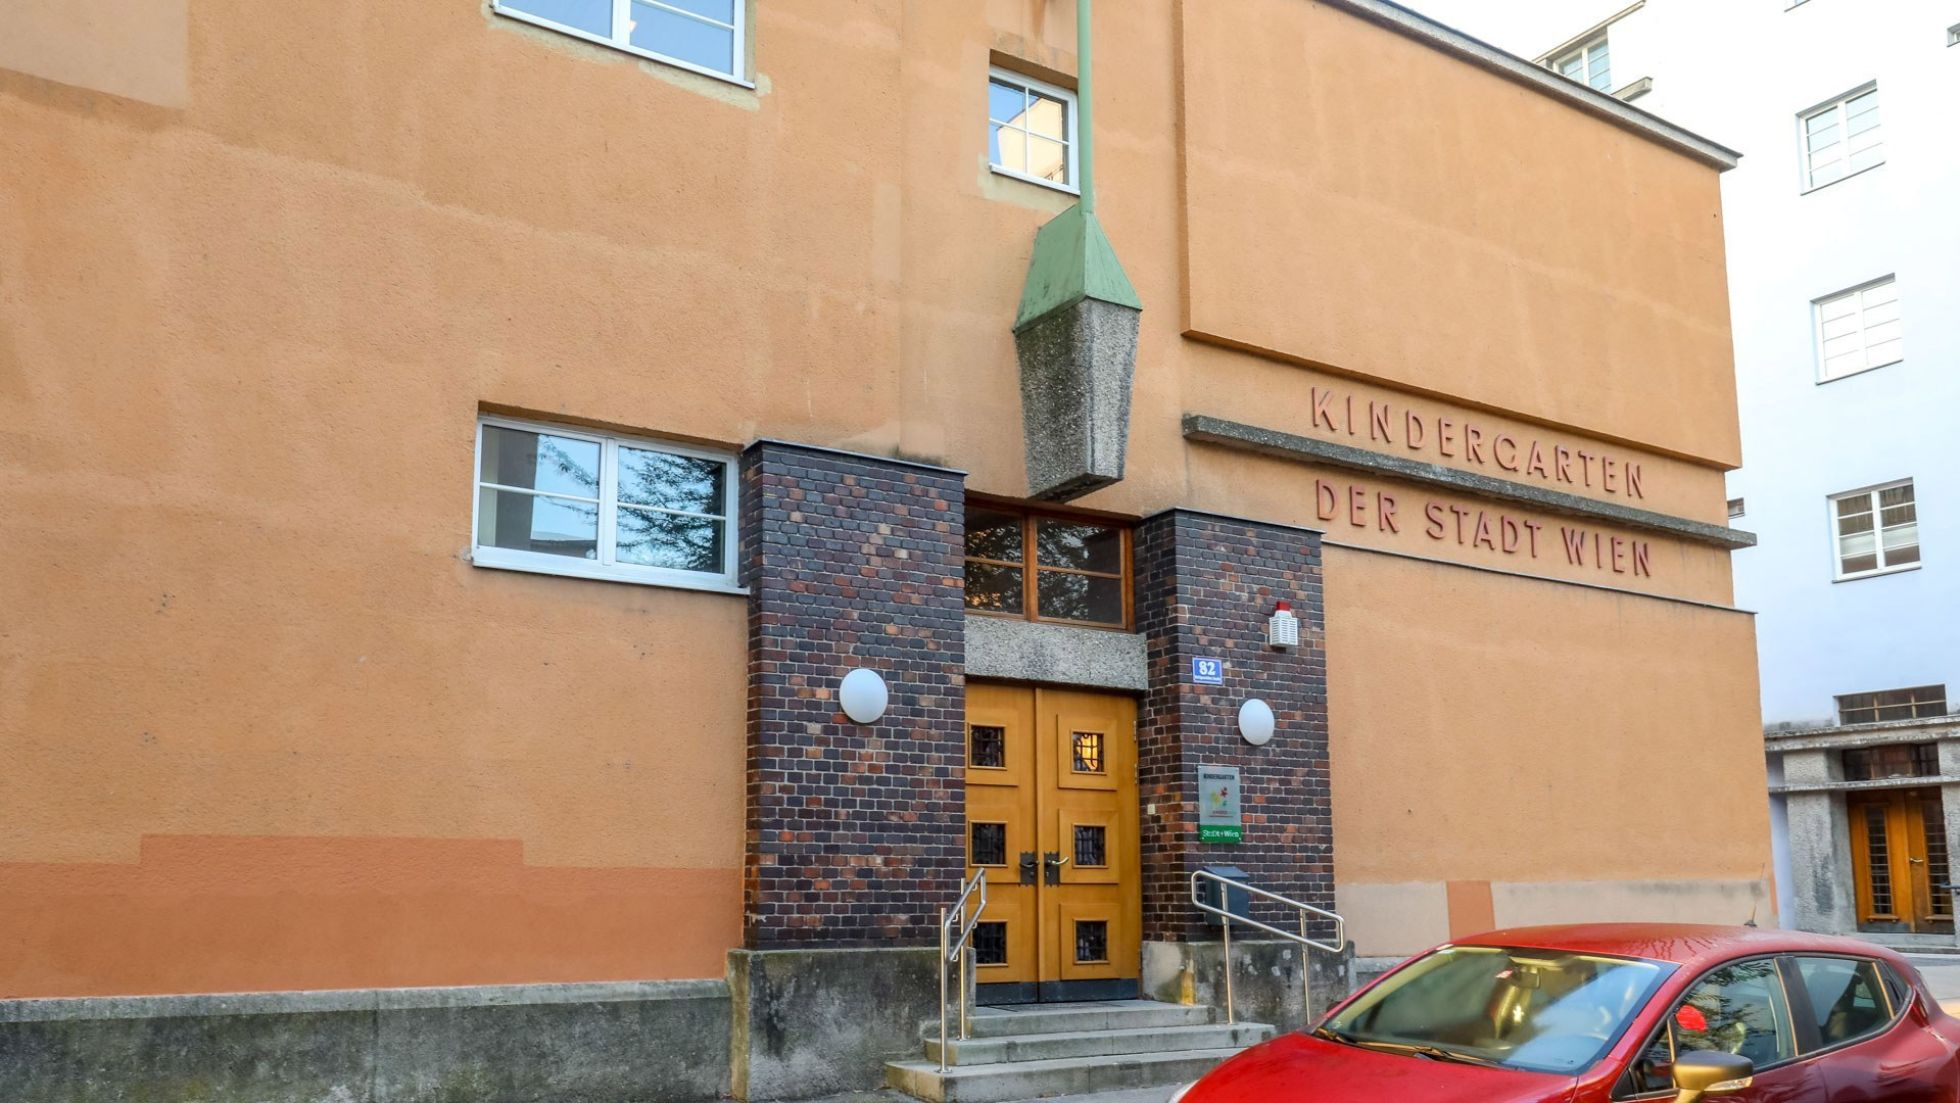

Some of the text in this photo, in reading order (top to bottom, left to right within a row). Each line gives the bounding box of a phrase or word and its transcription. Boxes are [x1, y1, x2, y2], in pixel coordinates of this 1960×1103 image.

[1312, 386, 1645, 499] KINDERGARTEN
[1316, 478, 1651, 578] DER STADT WIEN
[1198, 661, 1216, 675] 82
